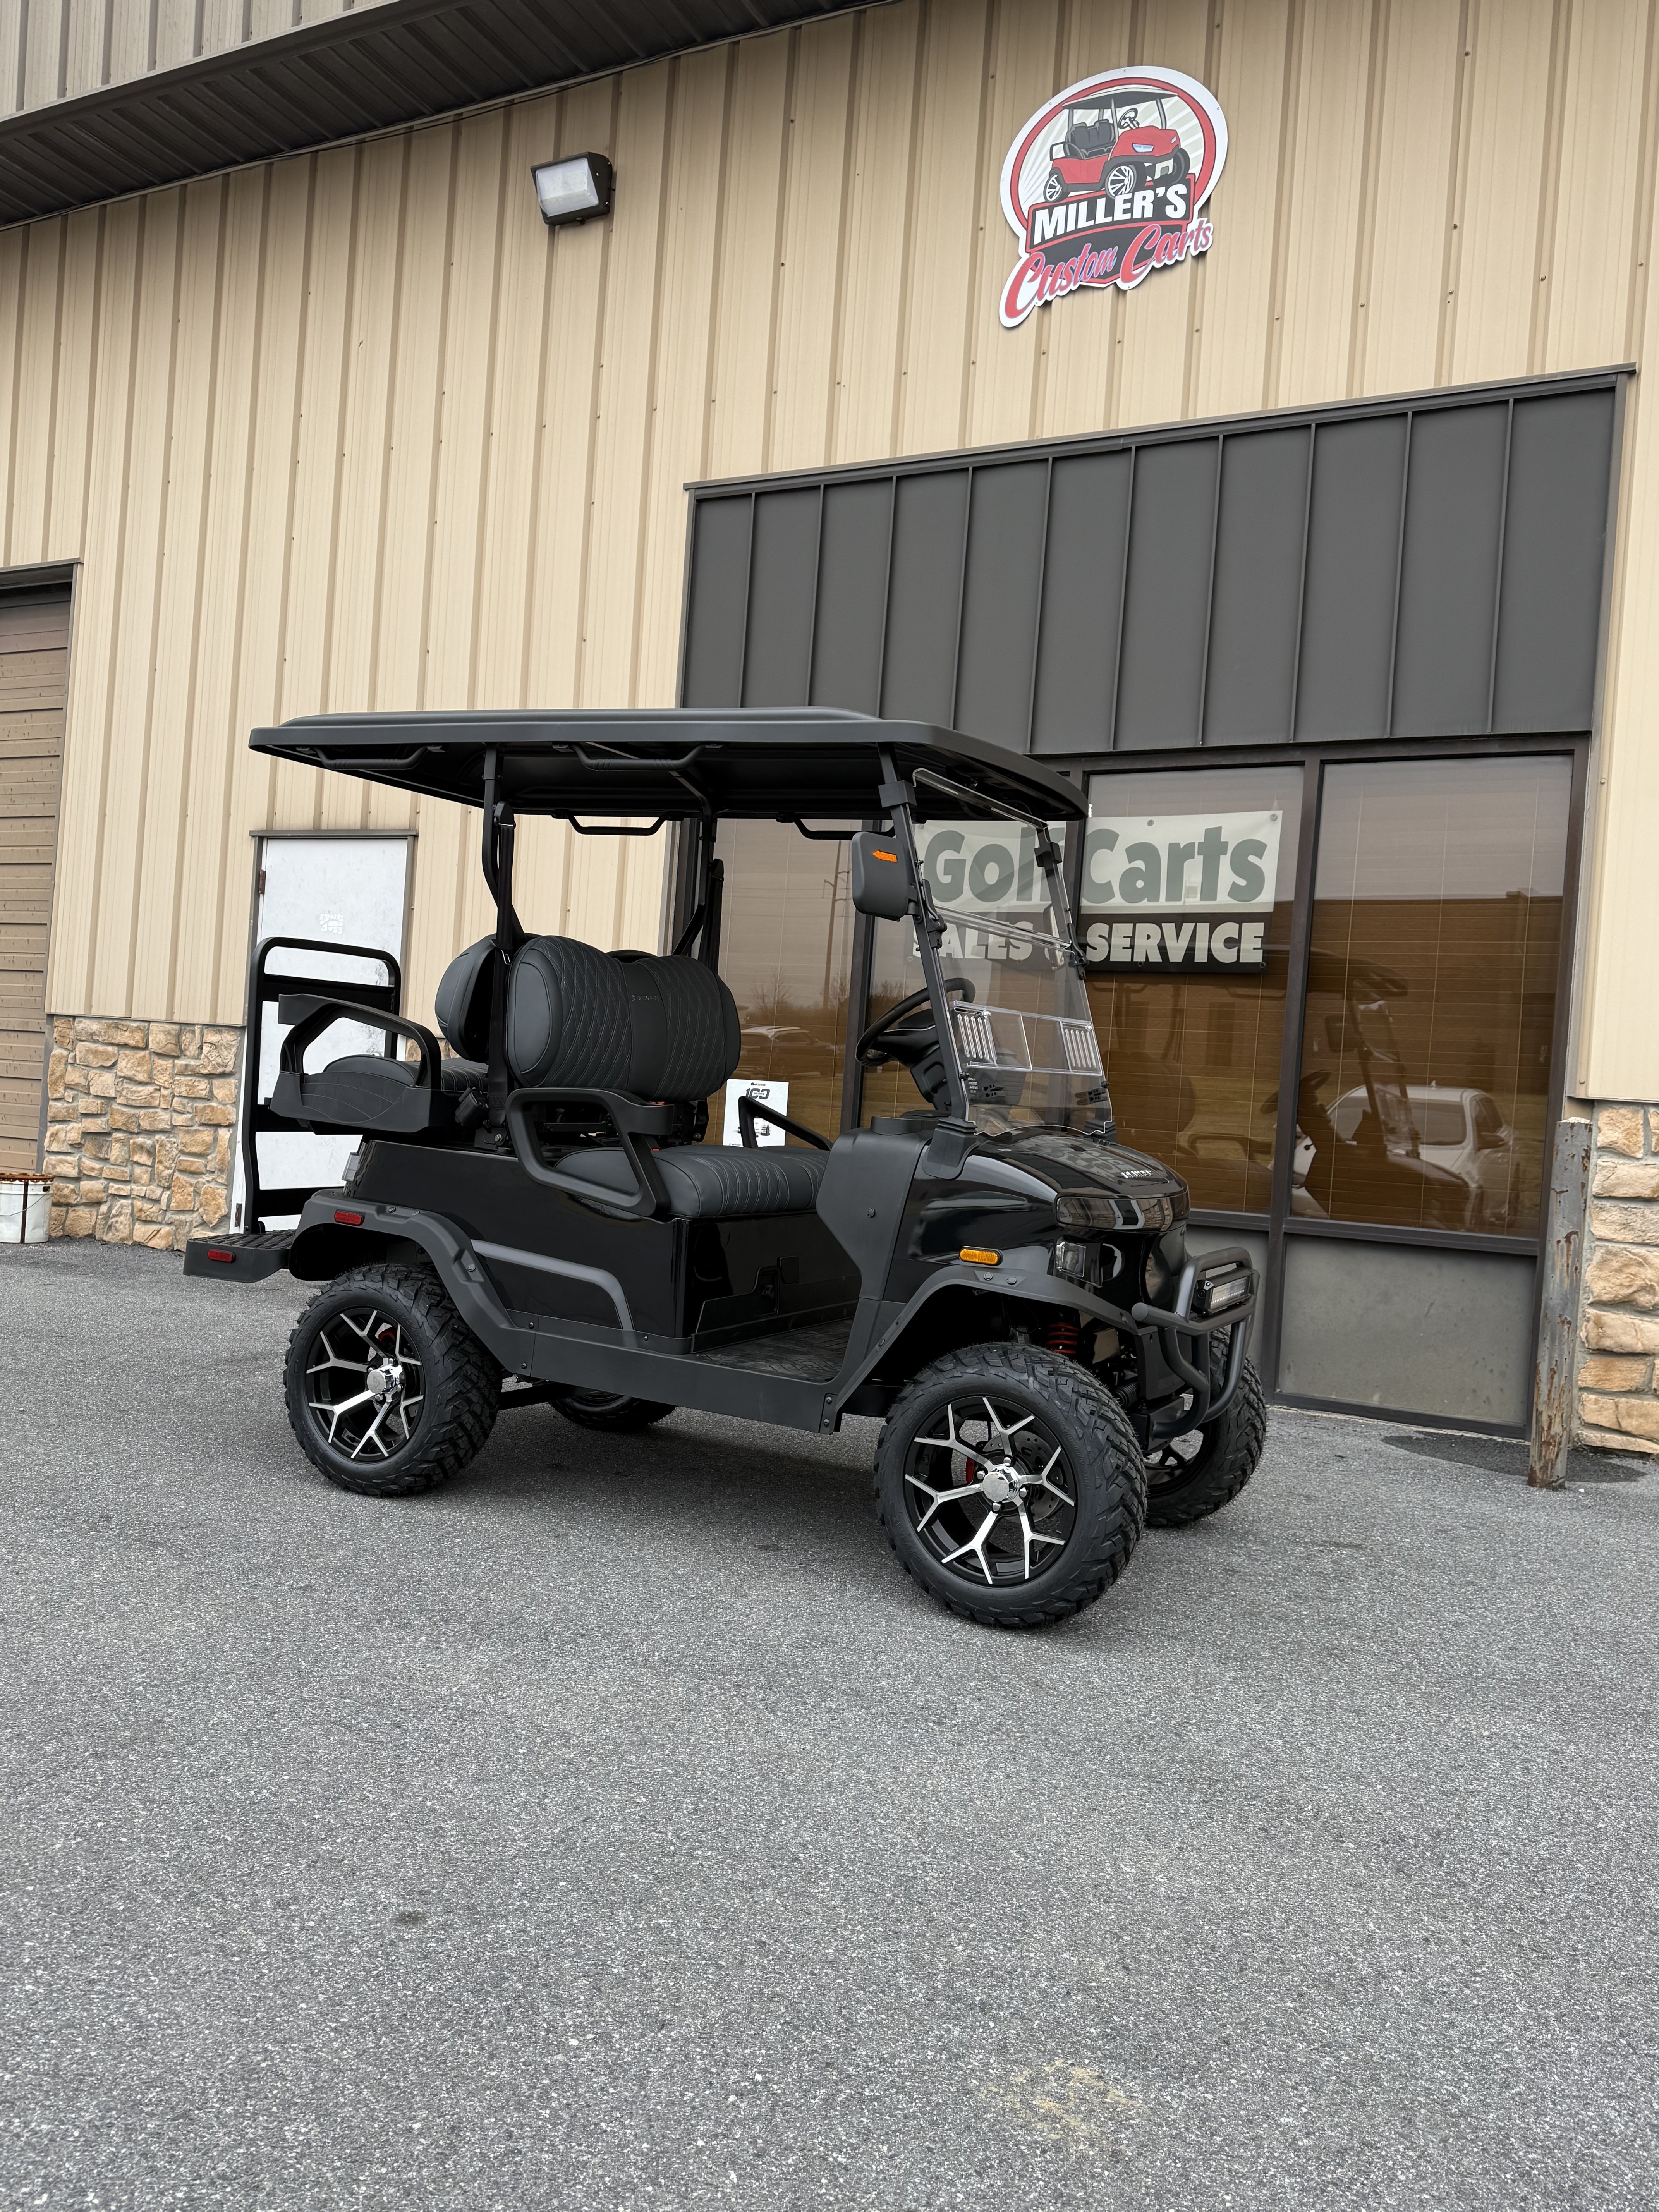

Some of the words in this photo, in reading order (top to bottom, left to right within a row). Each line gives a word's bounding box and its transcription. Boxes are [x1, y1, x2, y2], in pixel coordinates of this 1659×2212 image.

[1033, 183, 1187, 246] MILLER'S
[1005, 243, 1118, 319] Custom
[1120, 218, 1210, 283] Carts
[1082, 826, 1268, 904] Carts
[1086, 922, 1265, 963] SERVICE
